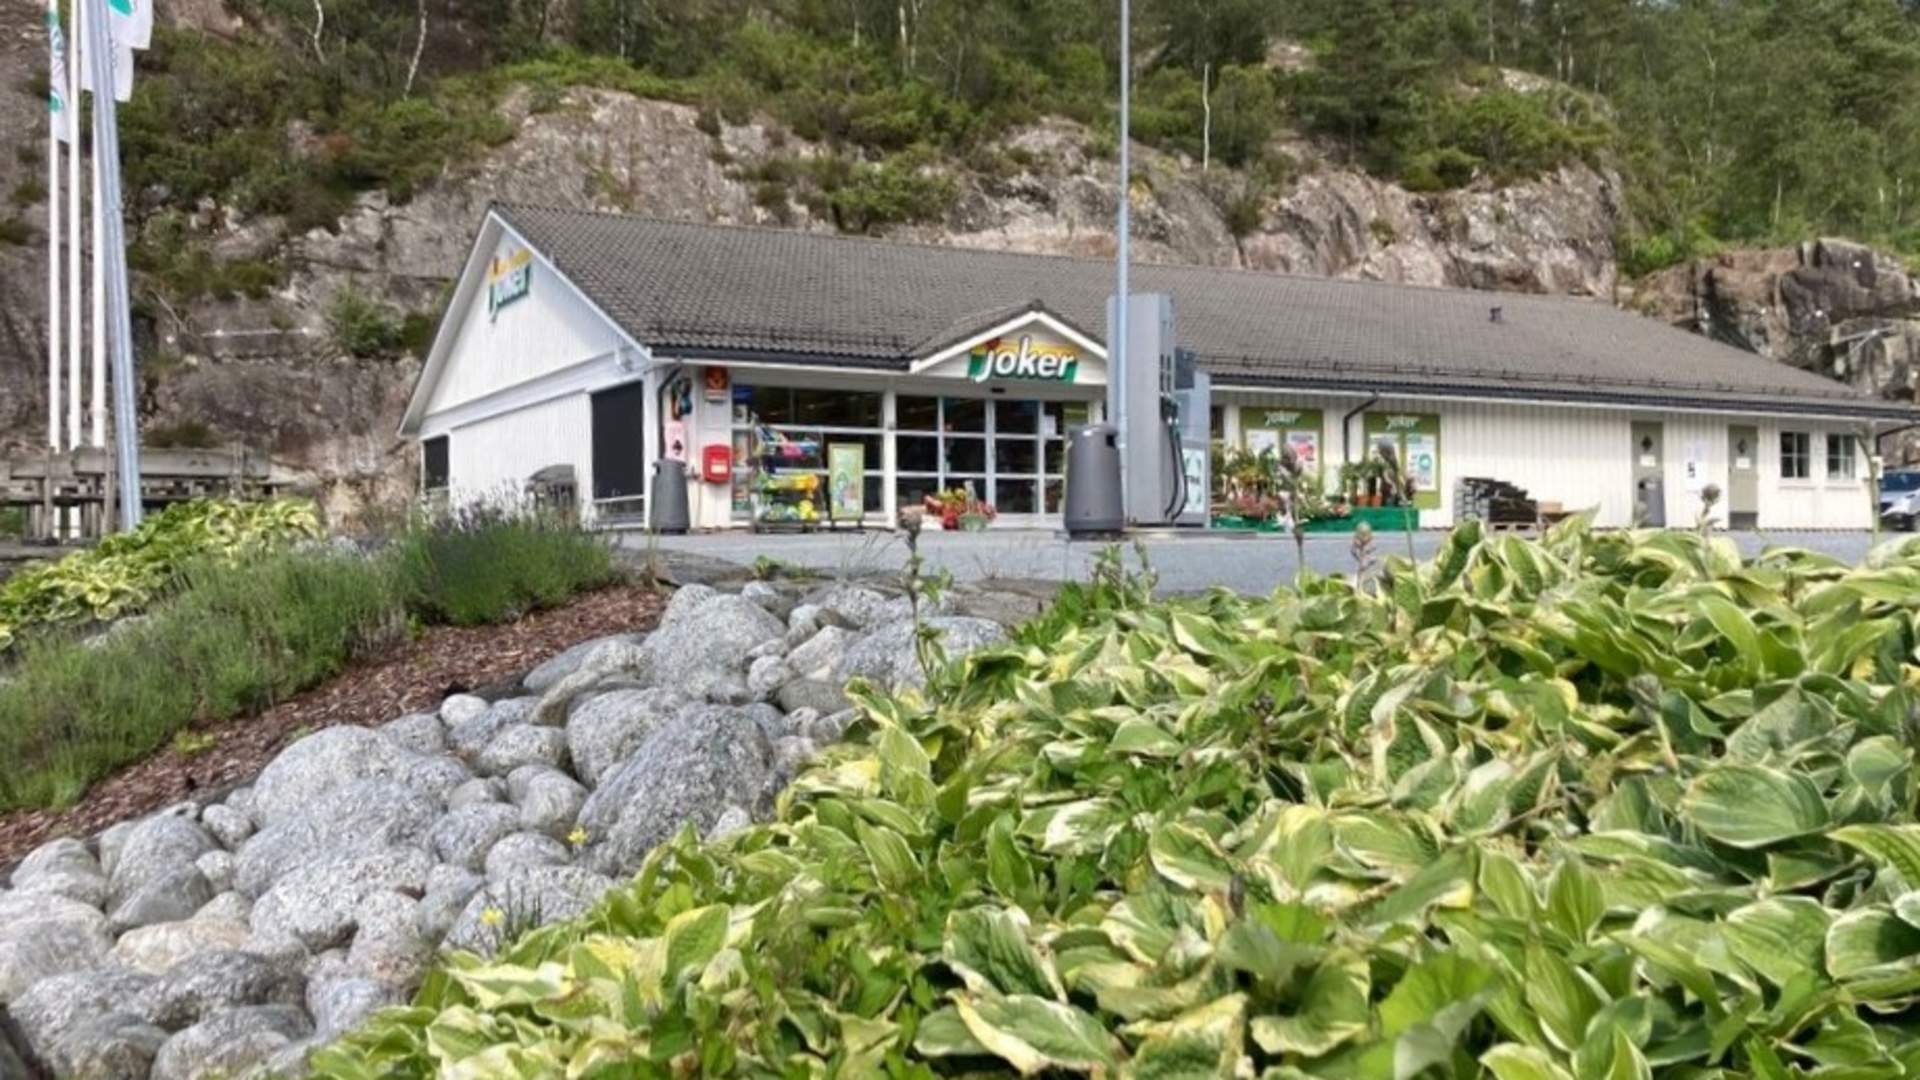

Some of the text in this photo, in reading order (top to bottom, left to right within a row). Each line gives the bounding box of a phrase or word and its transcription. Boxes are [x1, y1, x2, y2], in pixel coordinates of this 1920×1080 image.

[975, 337, 1075, 383] joker
[1264, 411, 1300, 426] joker
[1386, 414, 1420, 430] joker
